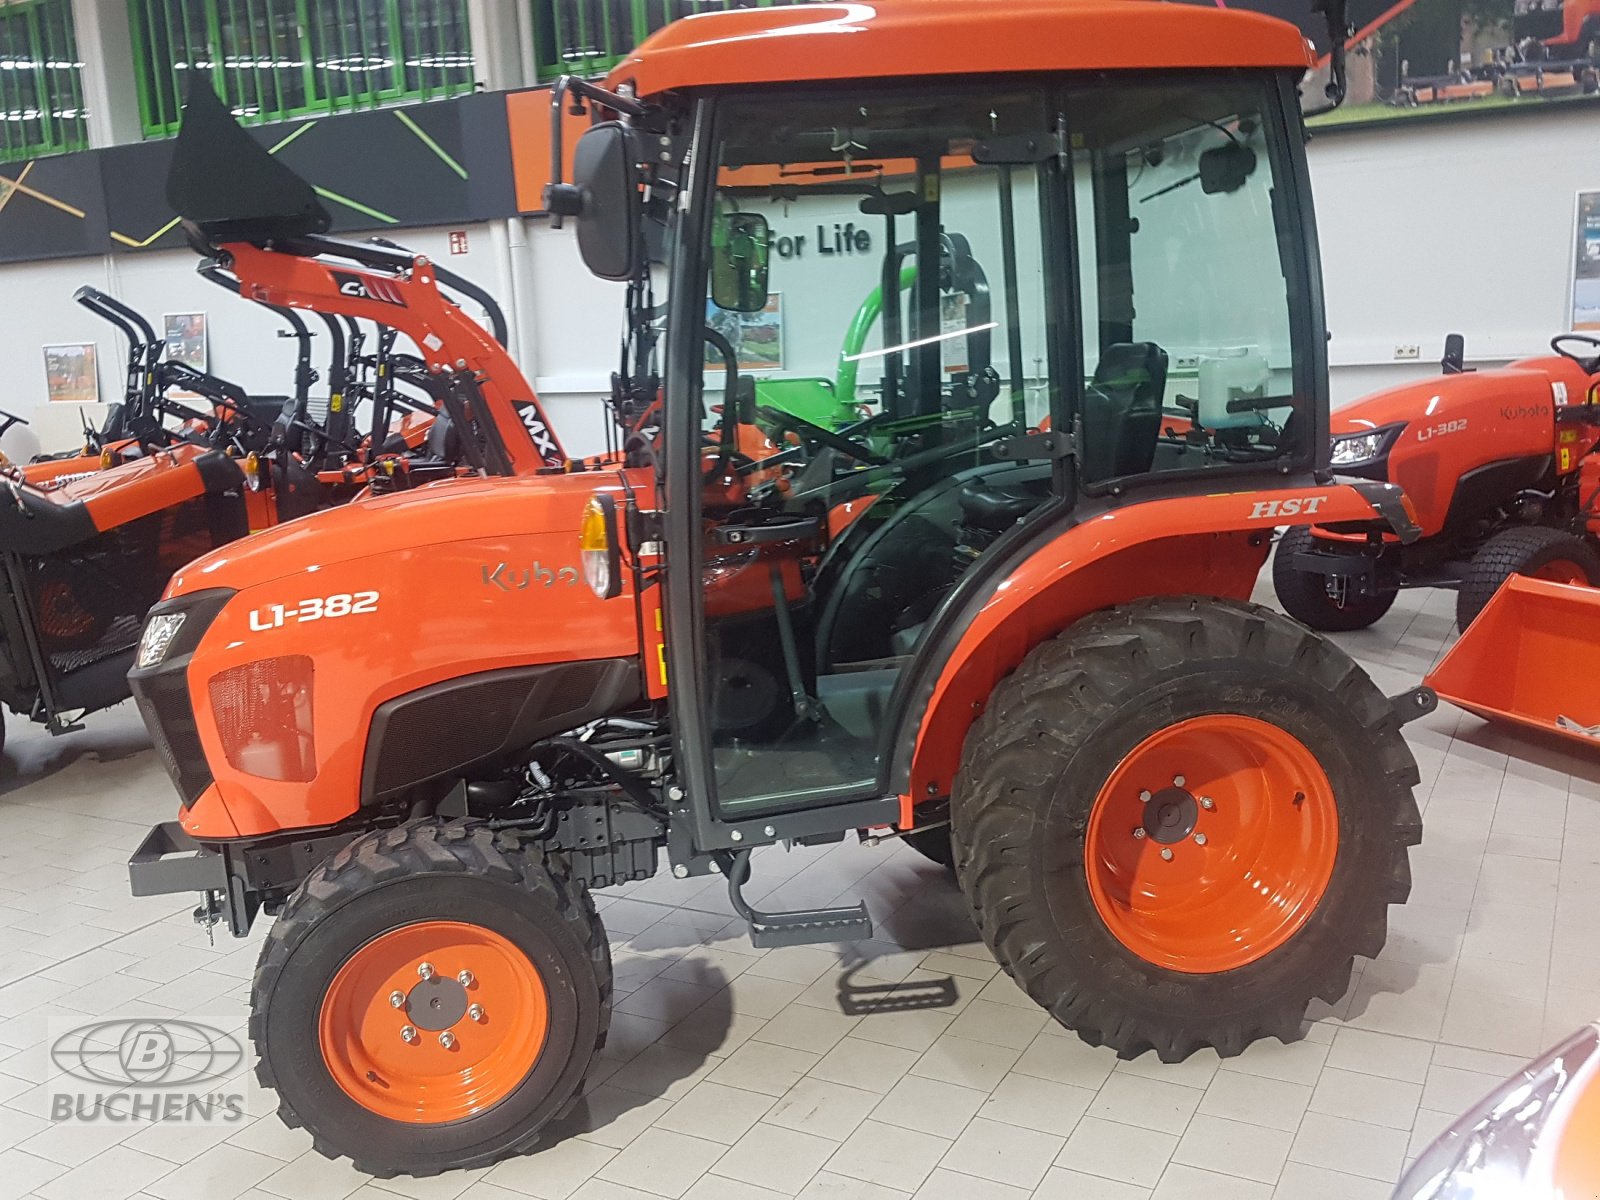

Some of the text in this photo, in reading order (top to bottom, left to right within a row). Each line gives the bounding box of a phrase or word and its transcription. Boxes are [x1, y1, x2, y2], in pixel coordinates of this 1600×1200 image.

[817, 222, 870, 253] Life
[1500, 404, 1548, 421] Kubota
[1417, 418, 1468, 441] L1-382
[1247, 496, 1328, 519] HST
[482, 560, 584, 592] Kubo
[249, 590, 380, 632] L1-382
